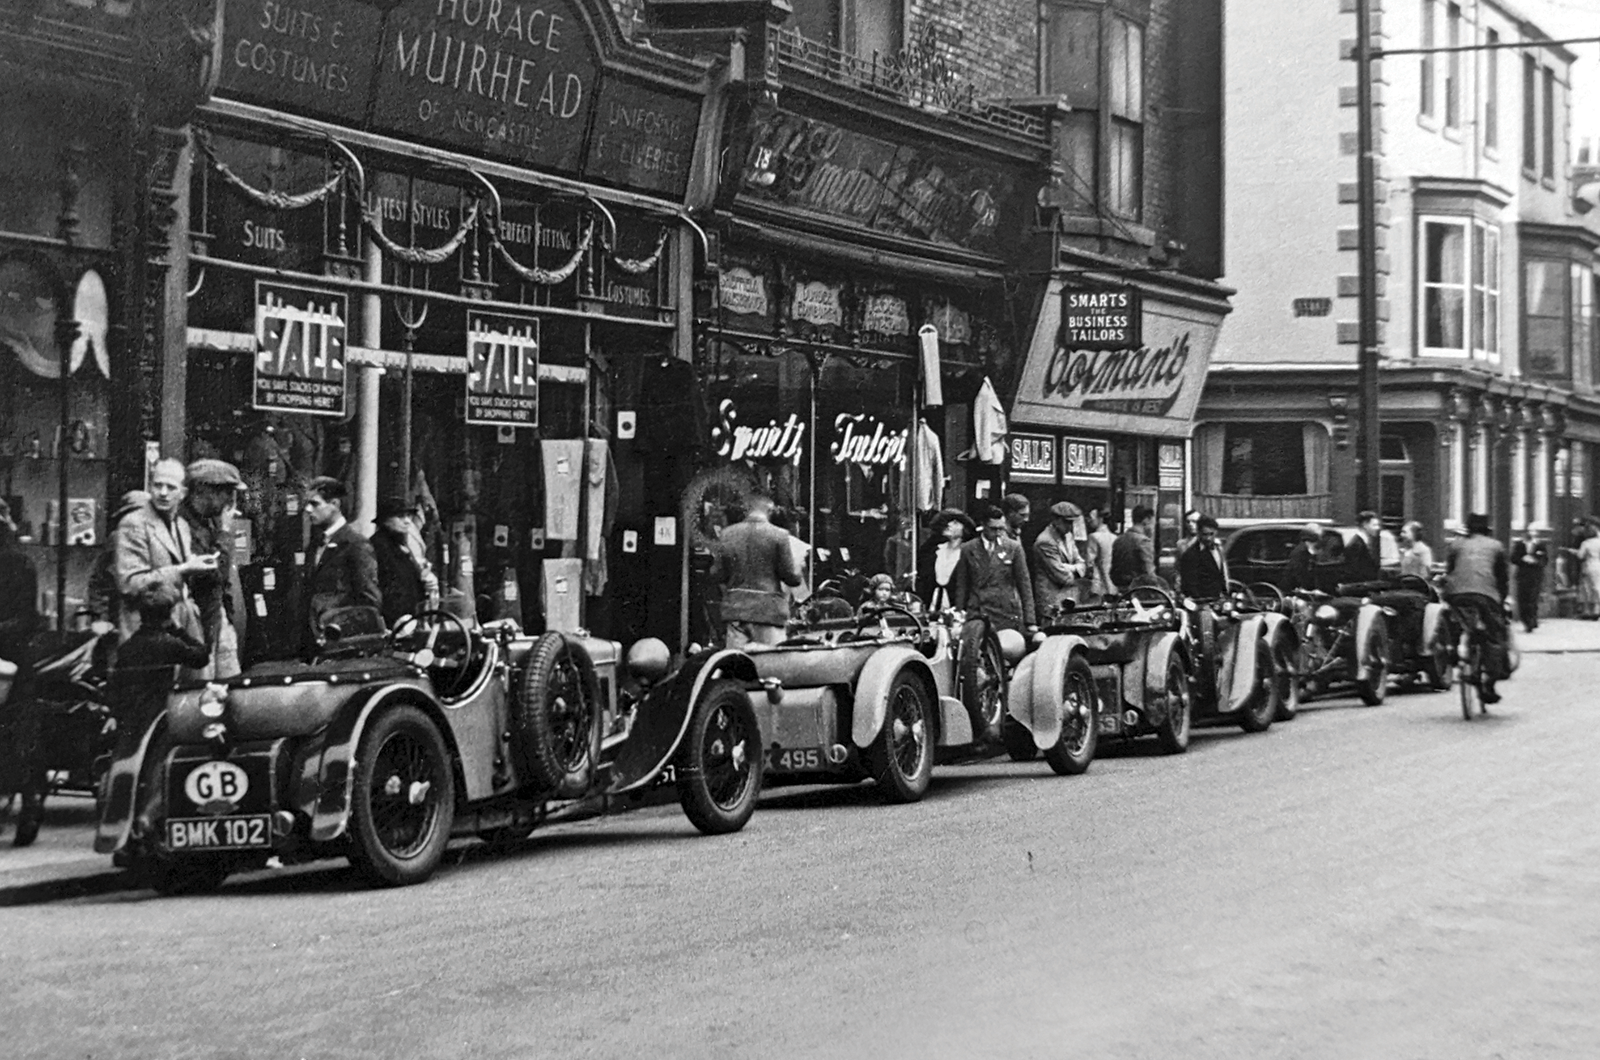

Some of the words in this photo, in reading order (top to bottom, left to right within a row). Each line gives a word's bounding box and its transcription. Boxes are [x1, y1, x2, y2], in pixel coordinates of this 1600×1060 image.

[260, 1, 322, 42] SUITS
[436, 0, 564, 53] HORACE
[235, 39, 349, 92] COSTUMES
[392, 31, 582, 119] MUIRHEAD
[418, 99, 440, 121] OF
[367, 191, 408, 222] LATEST
[412, 202, 452, 231] STYLES
[1069, 293, 1128, 308] SMARTS
[1090, 307, 1106, 315] THE
[1068, 315, 1128, 328] BUSINESS
[1070, 328, 1126, 342] TAILORS
[1011, 438, 1052, 471] SALE
[1067, 443, 1105, 475] SALE
[780, 749, 818, 770] 495
[171, 821, 220, 847] BMK
[224, 818, 264, 845] 102
